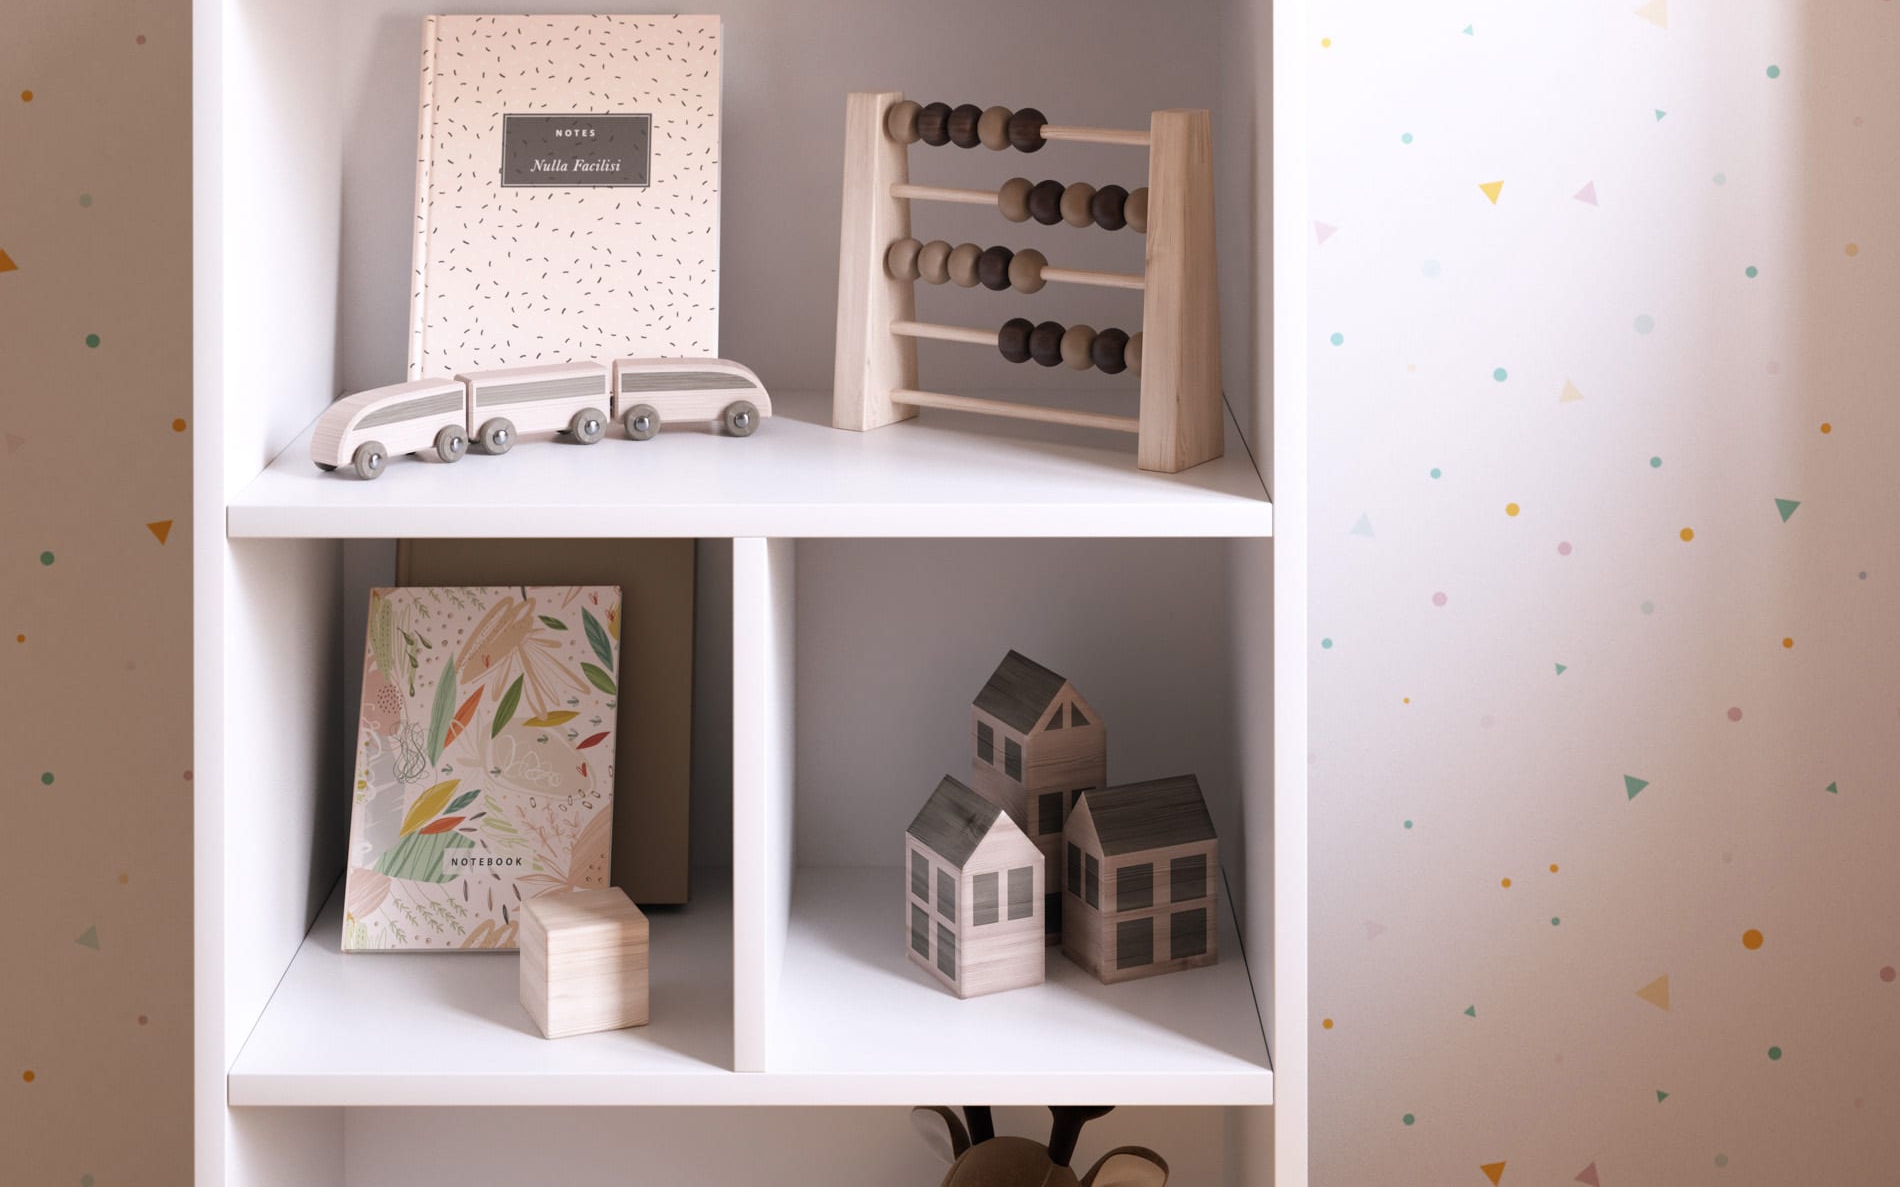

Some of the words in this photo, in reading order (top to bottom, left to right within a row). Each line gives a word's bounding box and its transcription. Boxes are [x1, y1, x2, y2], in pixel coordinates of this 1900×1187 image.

[555, 129, 596, 137] NOTES
[530, 159, 568, 172] Nulla
[572, 159, 621, 172] Facilisi
[451, 857, 522, 866] NOTEBOOK
